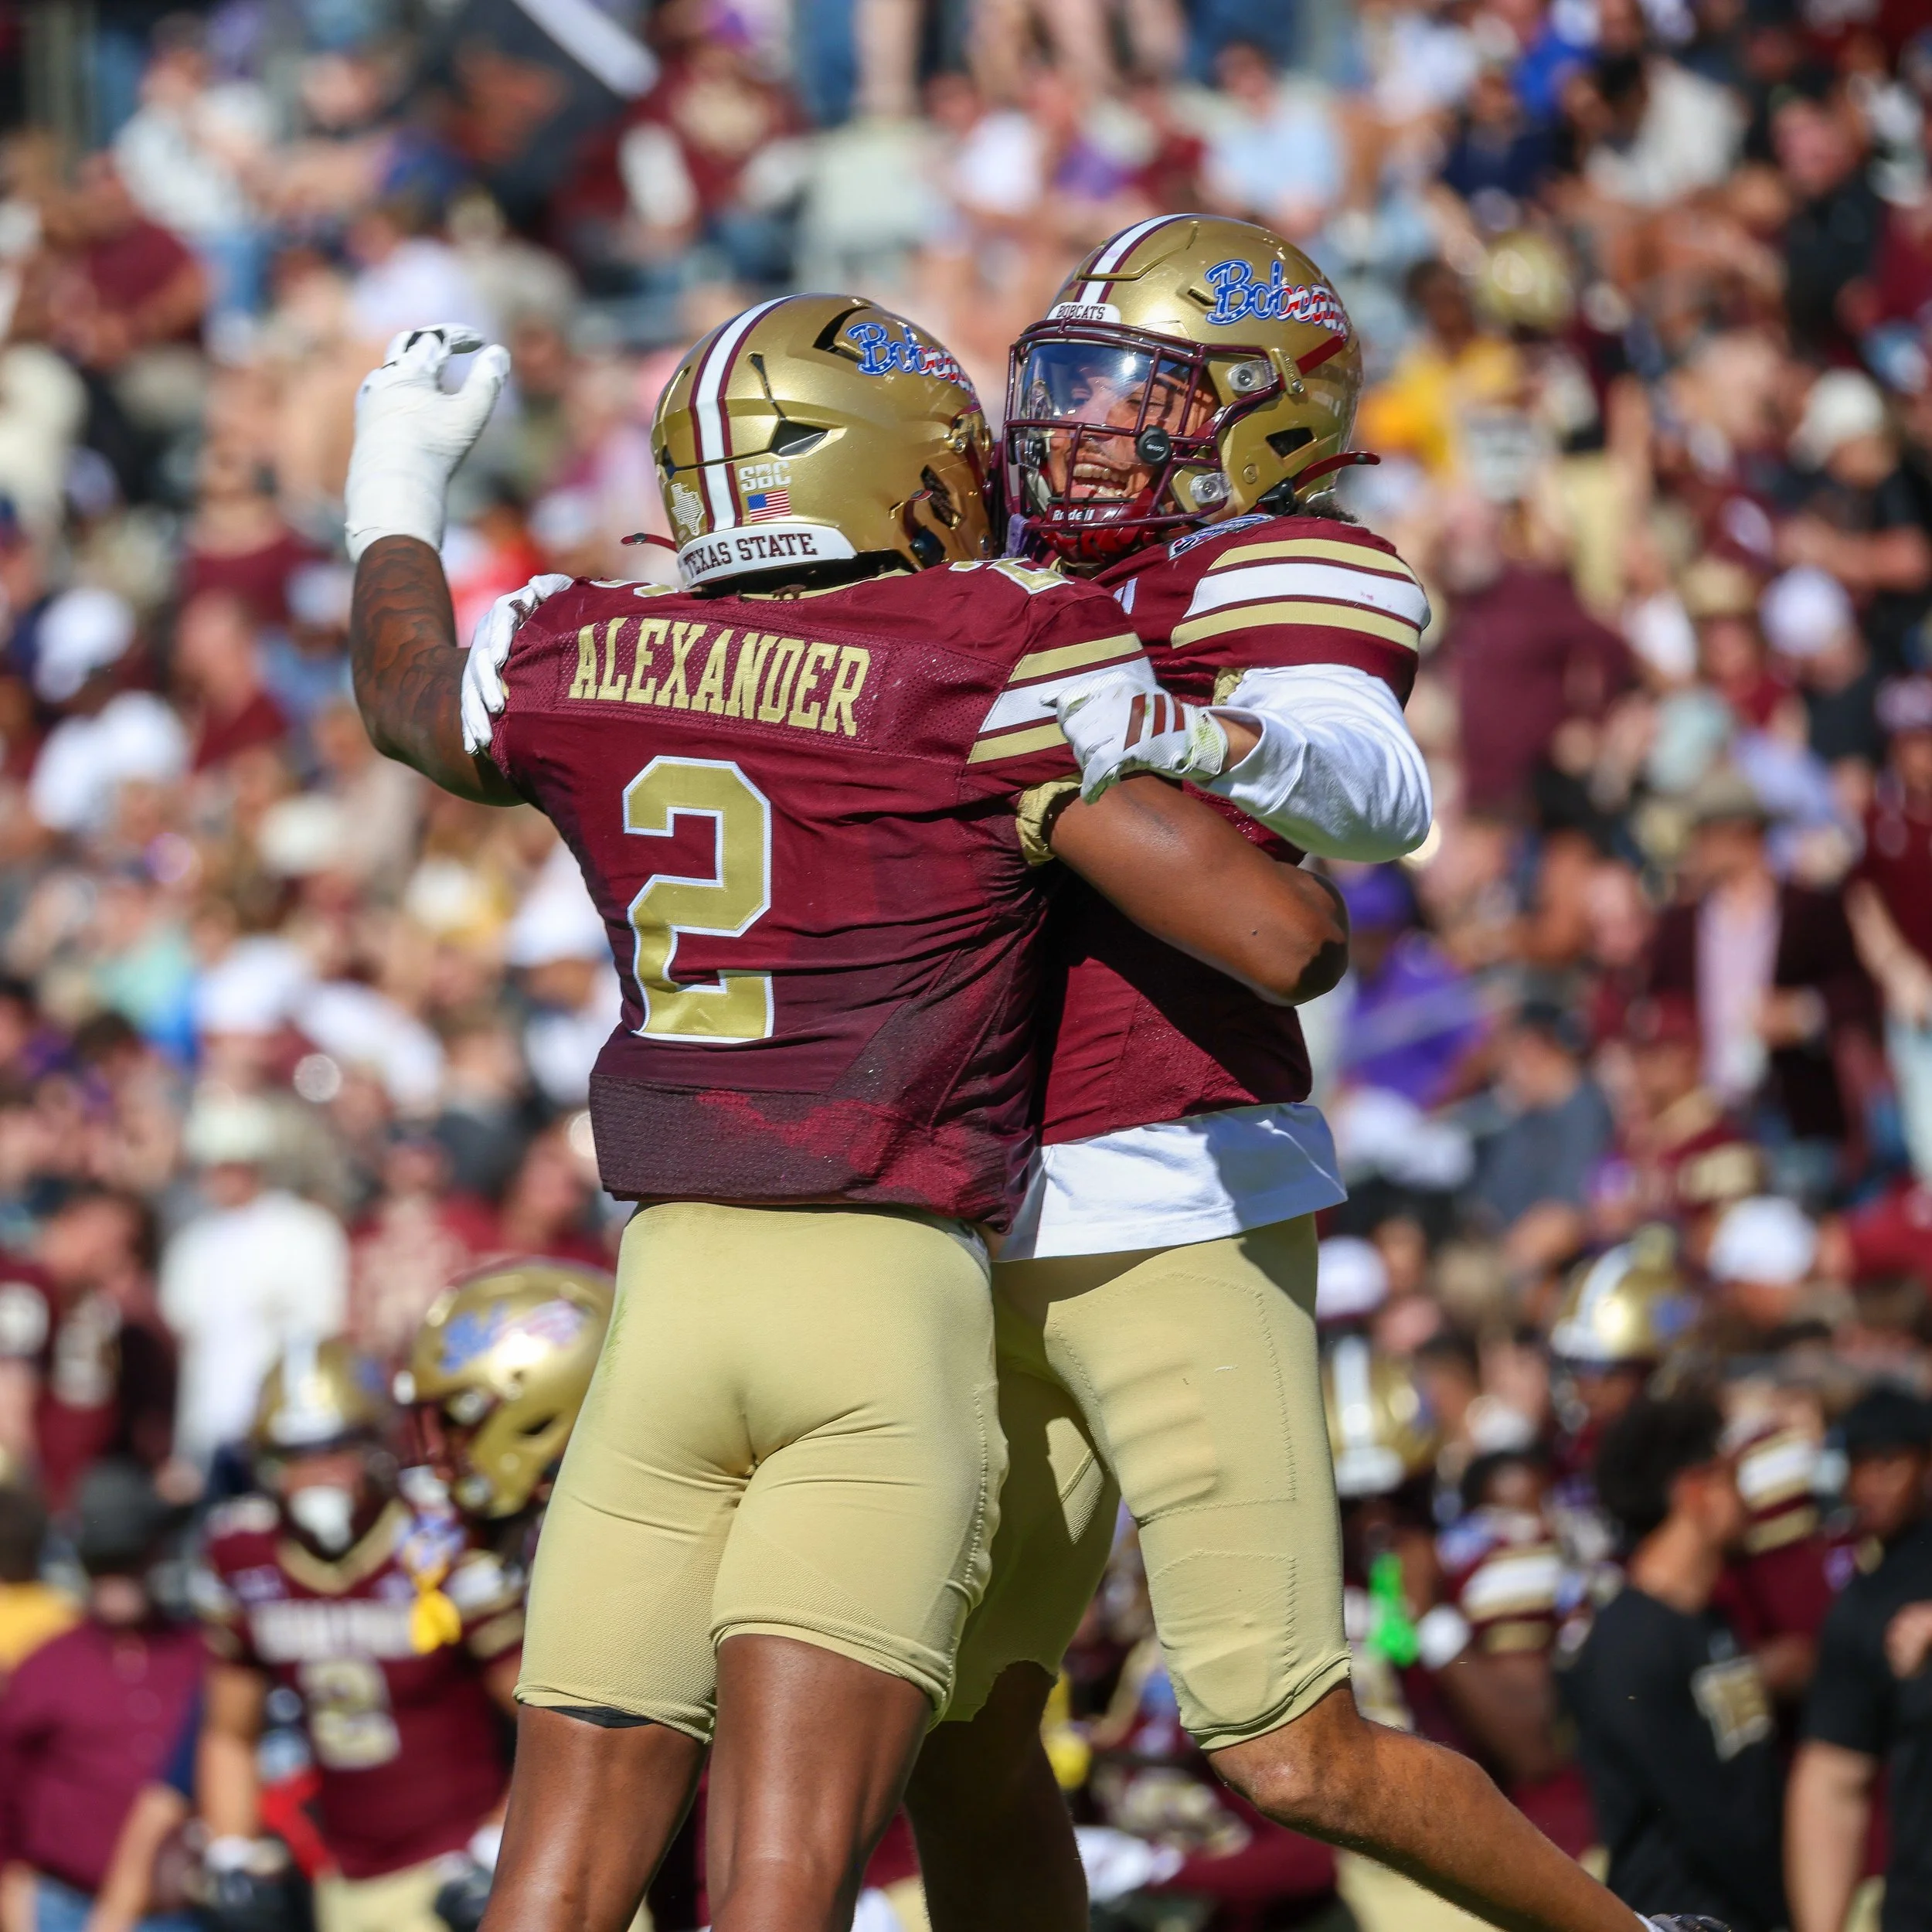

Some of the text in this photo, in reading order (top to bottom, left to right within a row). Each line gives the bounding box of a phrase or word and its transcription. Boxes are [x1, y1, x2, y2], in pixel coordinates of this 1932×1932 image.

[1056, 304, 1105, 319] BOBCATS
[683, 533, 818, 578] TEXAS STATE
[569, 617, 871, 736] ALEXANDER
[623, 755, 773, 1043] 2
